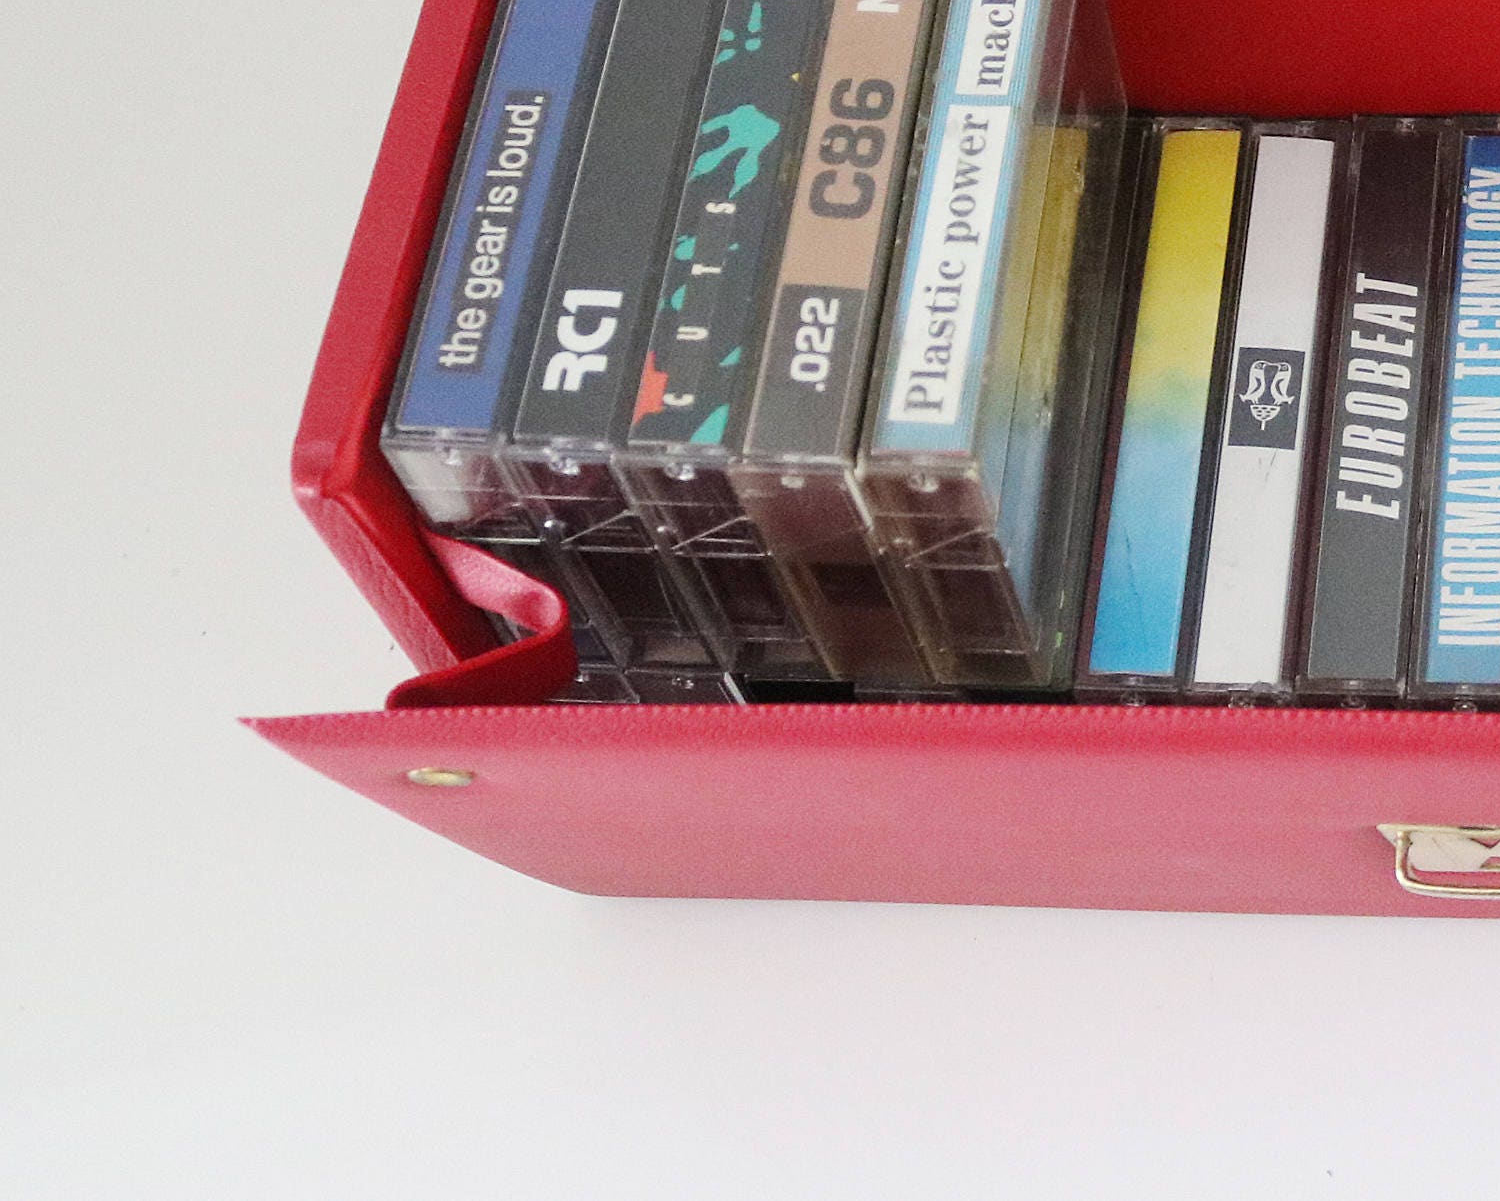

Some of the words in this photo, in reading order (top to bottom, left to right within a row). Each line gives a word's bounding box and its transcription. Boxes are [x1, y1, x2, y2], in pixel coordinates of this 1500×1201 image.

[487, 94, 545, 178] loud.
[810, 77, 895, 220] C86
[475, 184, 518, 213] is
[463, 218, 509, 301] gear
[903, 260, 967, 413] Plastic
[943, 113, 990, 248] power
[438, 306, 487, 368] the
[543, 289, 623, 392] RC1
[790, 297, 840, 391] .022
[1335, 272, 1418, 520] EUROBEAT
